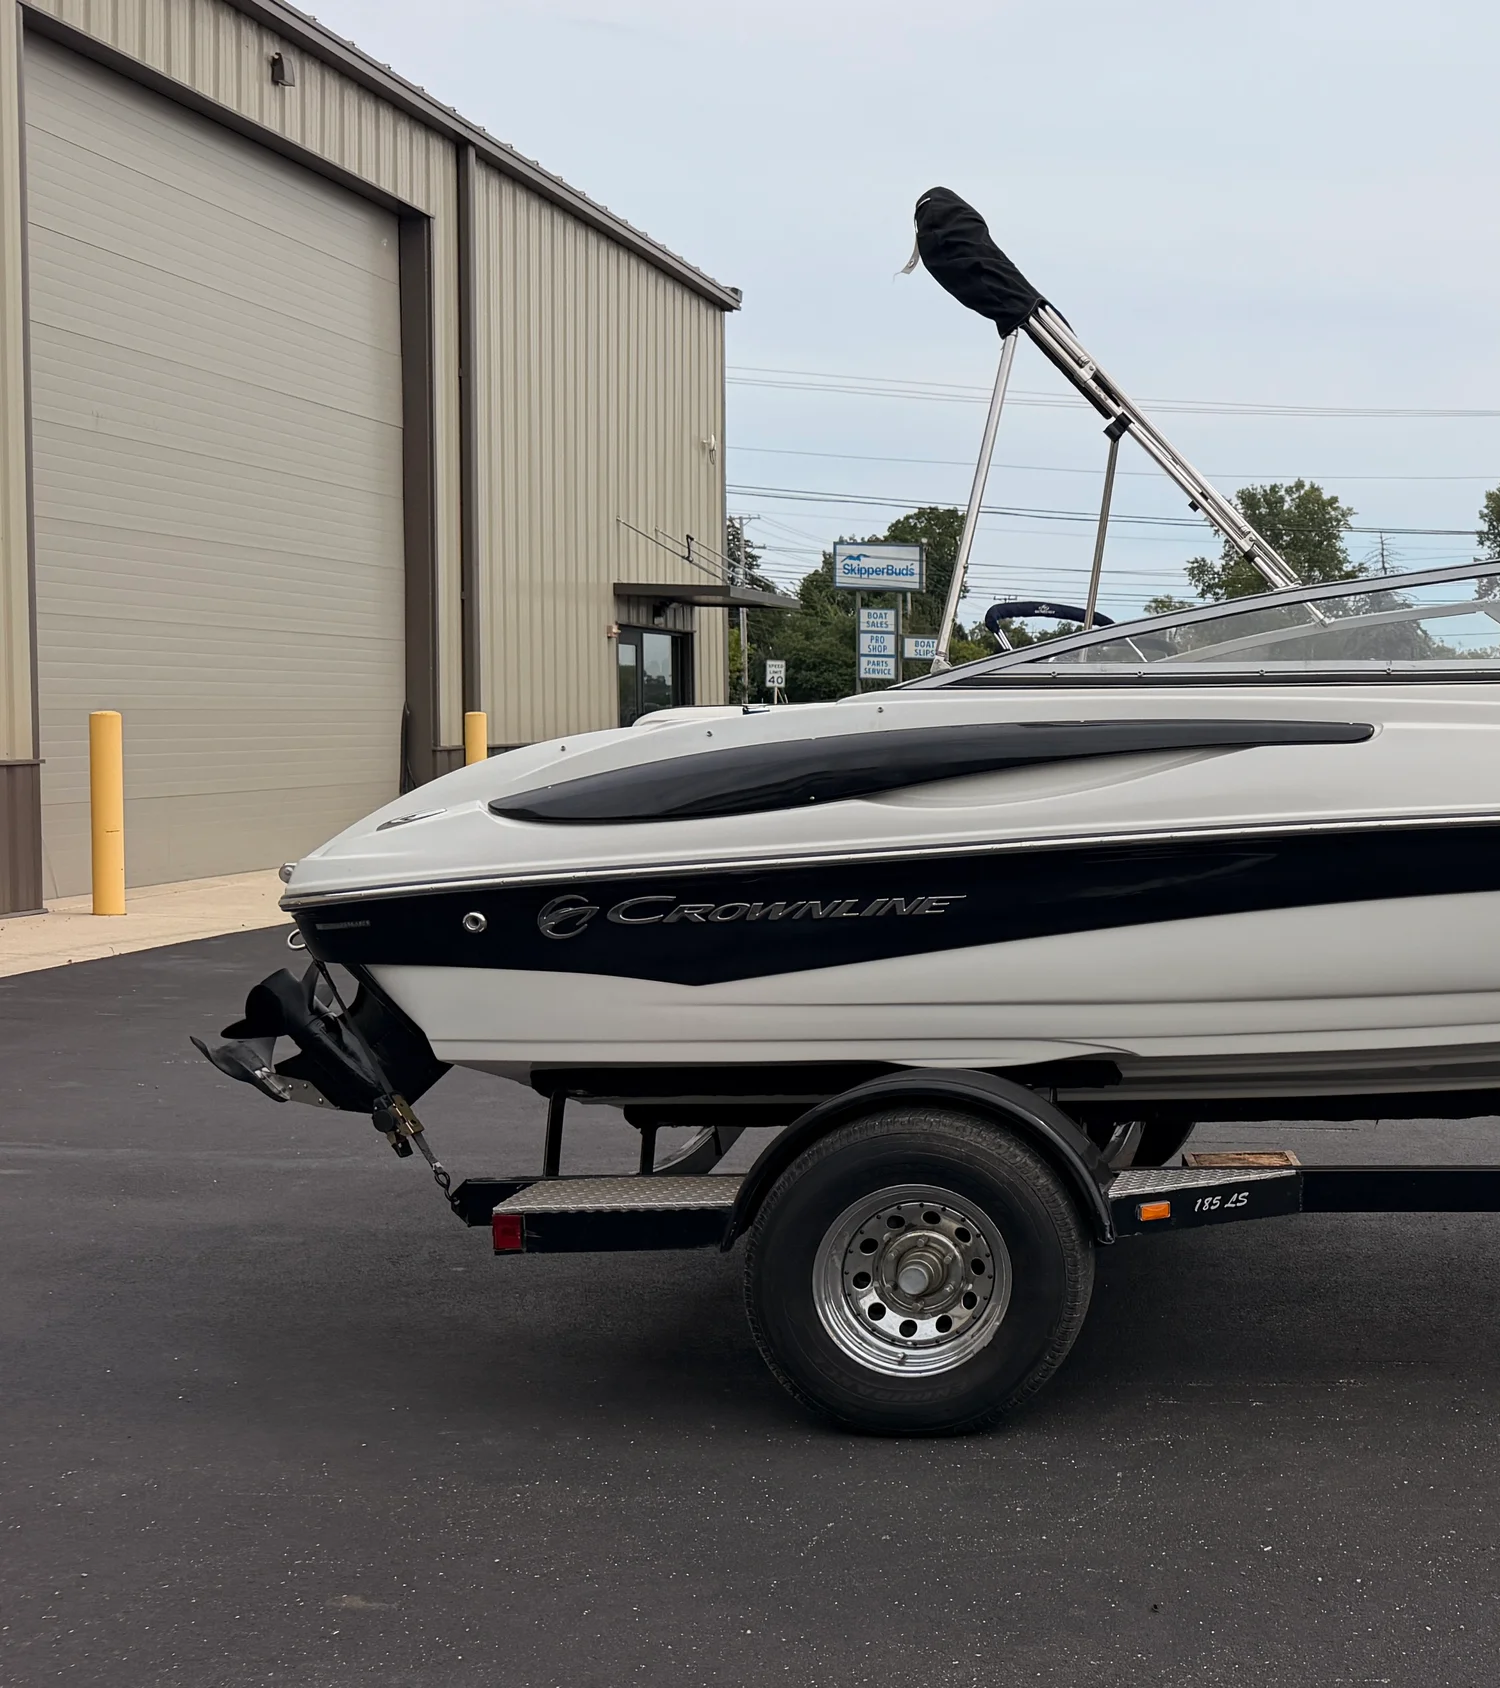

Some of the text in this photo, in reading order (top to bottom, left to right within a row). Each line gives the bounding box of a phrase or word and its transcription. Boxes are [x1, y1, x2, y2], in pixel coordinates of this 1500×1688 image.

[867, 611, 889, 620] BOAT
[866, 620, 889, 629] SALES
[870, 635, 885, 644] PRO
[867, 644, 888, 653] SHOP
[914, 640, 936, 649] BOAT
[914, 649, 935, 657] SLIPS
[864, 667, 892, 676] SERVICE
[768, 675, 784, 685] 40
[606, 894, 967, 924] CROWNLINE
[1194, 1191, 1249, 1213] 185 LS
